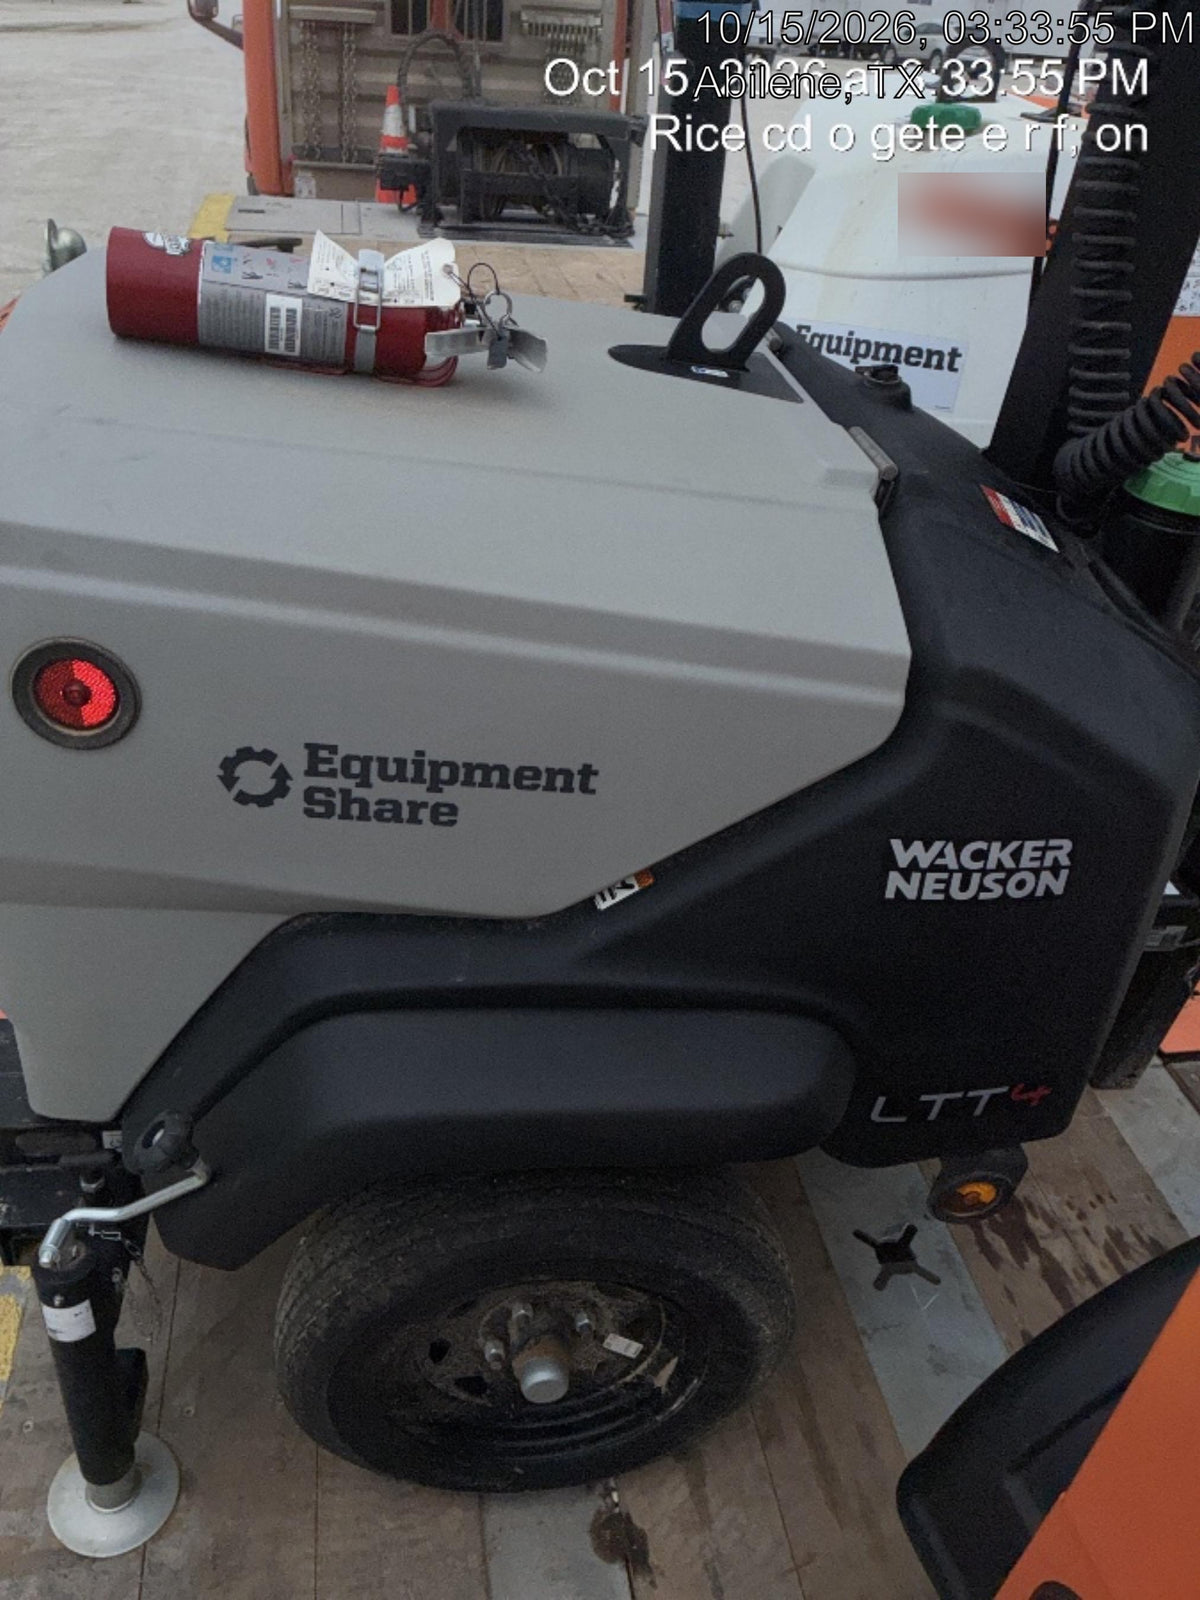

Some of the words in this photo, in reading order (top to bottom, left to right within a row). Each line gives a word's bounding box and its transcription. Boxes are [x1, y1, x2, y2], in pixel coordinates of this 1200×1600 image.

[303, 742, 600, 795] Equipment
[303, 785, 460, 827] Share
[889, 838, 1074, 870] WACKER
[885, 869, 1070, 901] NEUSON
[870, 1082, 1053, 1123] LTT4
